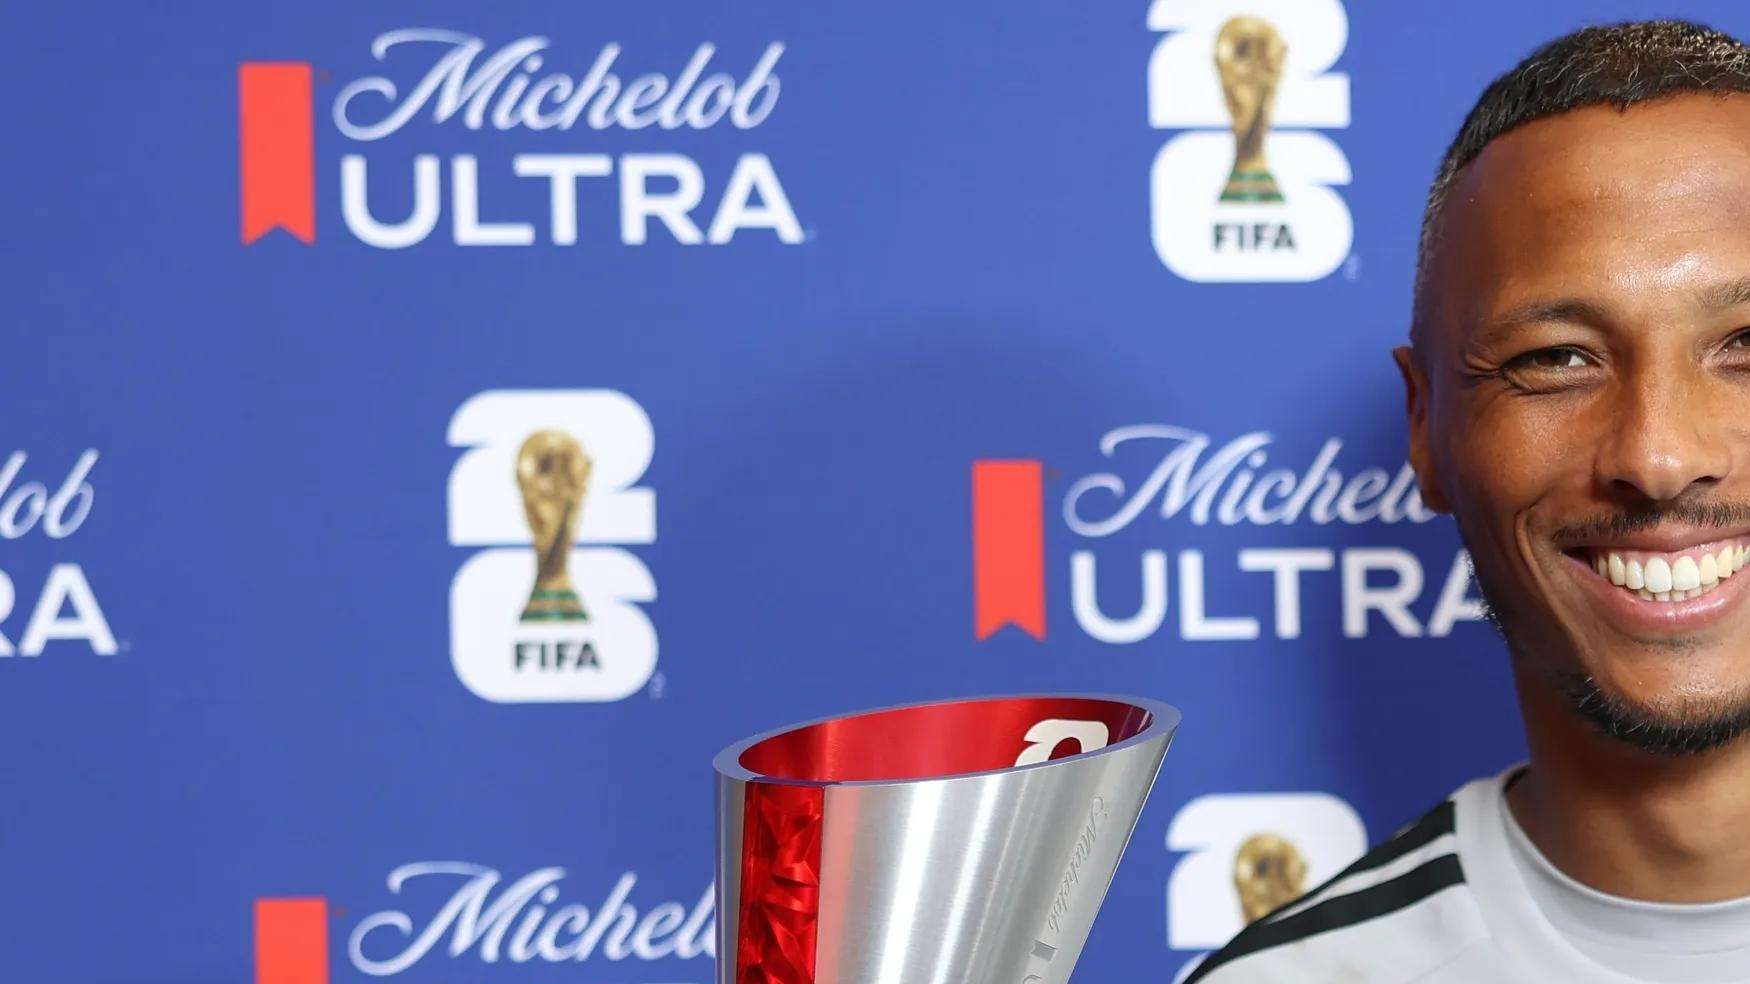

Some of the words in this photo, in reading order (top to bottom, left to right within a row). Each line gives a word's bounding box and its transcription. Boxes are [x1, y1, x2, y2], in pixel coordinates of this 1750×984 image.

[333, 29, 785, 141] Michelob
[341, 154, 804, 249] ULTRA
[1212, 222, 1297, 252] FIFA
[1063, 424, 1436, 537] Michel
[514, 640, 602, 671] FIFA
[349, 861, 716, 976] Michel
